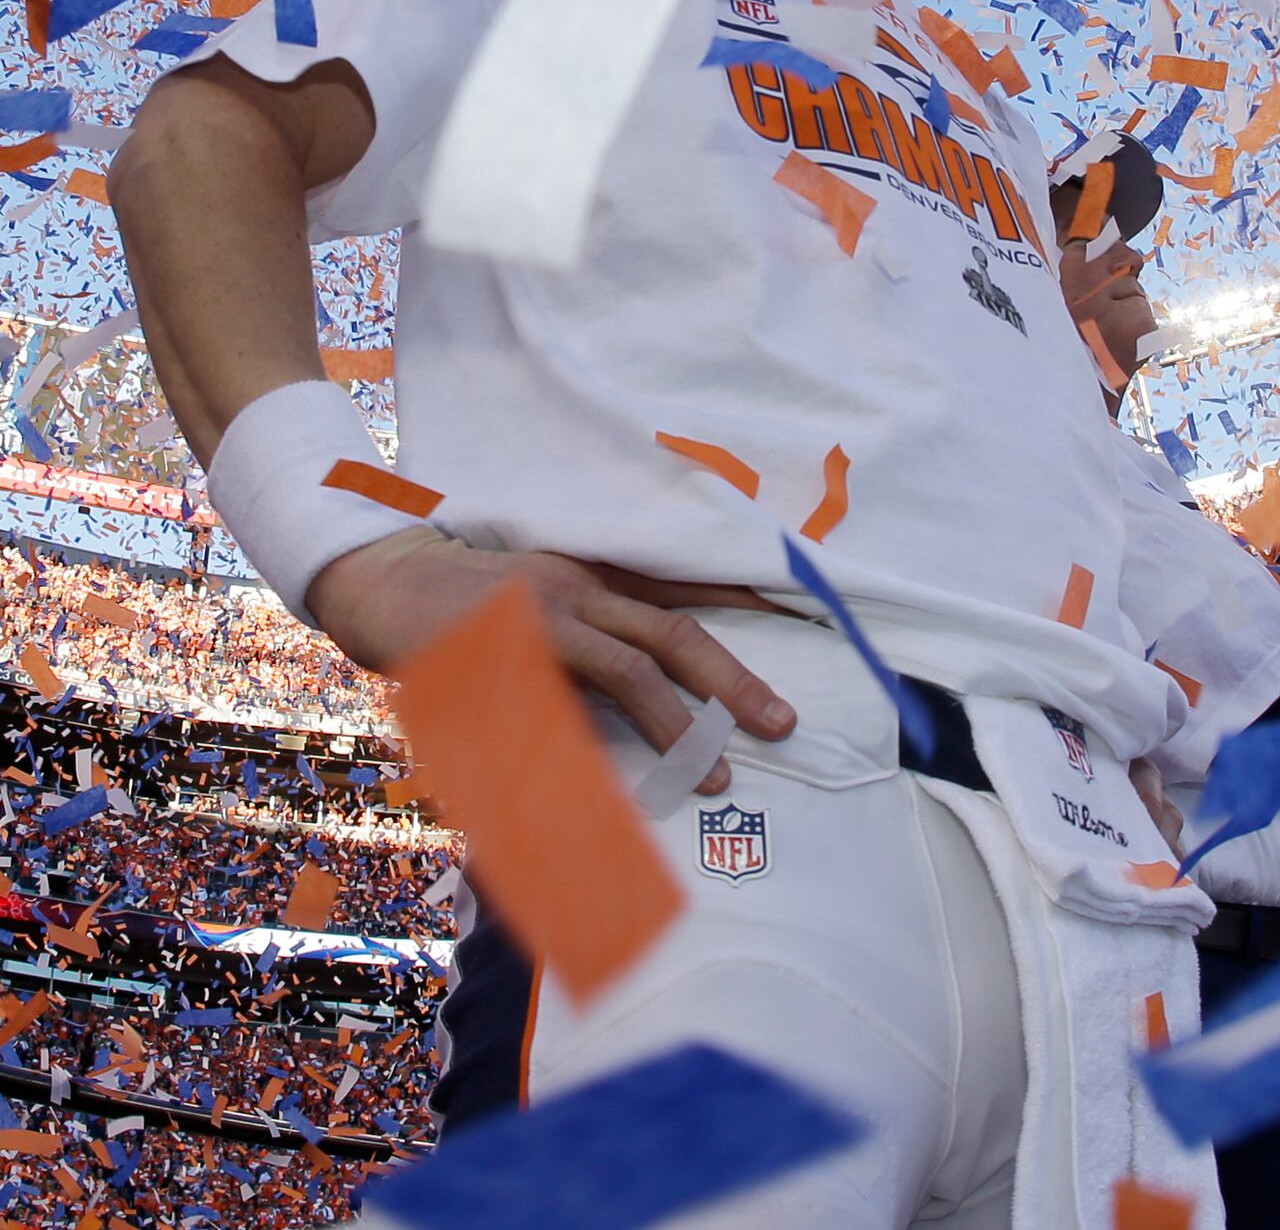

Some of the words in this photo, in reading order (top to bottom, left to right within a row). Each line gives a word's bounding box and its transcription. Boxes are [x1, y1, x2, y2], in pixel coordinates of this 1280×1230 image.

[735, 0, 777, 22] NFL
[886, 173, 966, 229] DENVER
[967, 223, 1051, 275] BRONCO
[1052, 792, 1129, 848] Wilson
[706, 836, 761, 872] NFL
